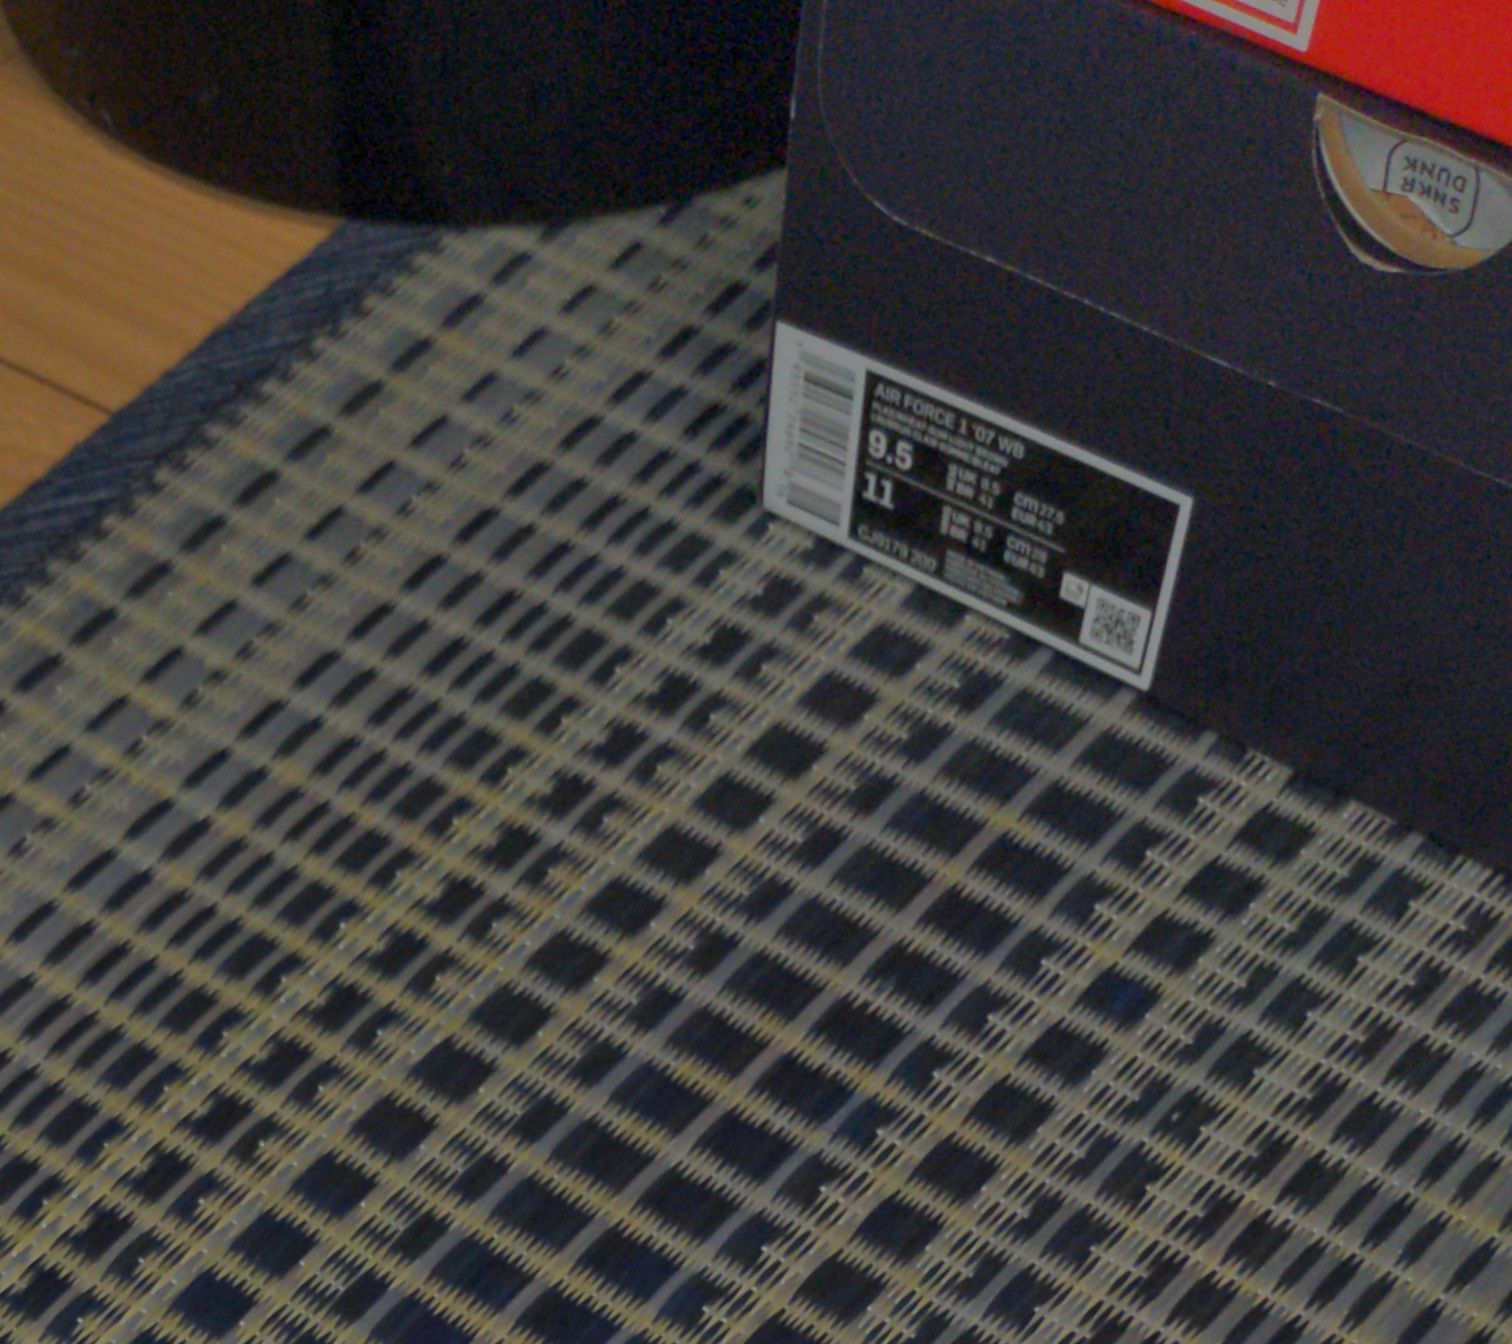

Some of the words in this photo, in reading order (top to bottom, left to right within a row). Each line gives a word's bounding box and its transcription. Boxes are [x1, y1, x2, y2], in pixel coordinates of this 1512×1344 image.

[1402, 156, 1467, 193] DUNK
[874, 381, 901, 406] AIR
[903, 394, 955, 429] FORCE
[959, 418, 967, 435] 1
[866, 426, 914, 474] 9.5
[861, 469, 897, 511] 11
